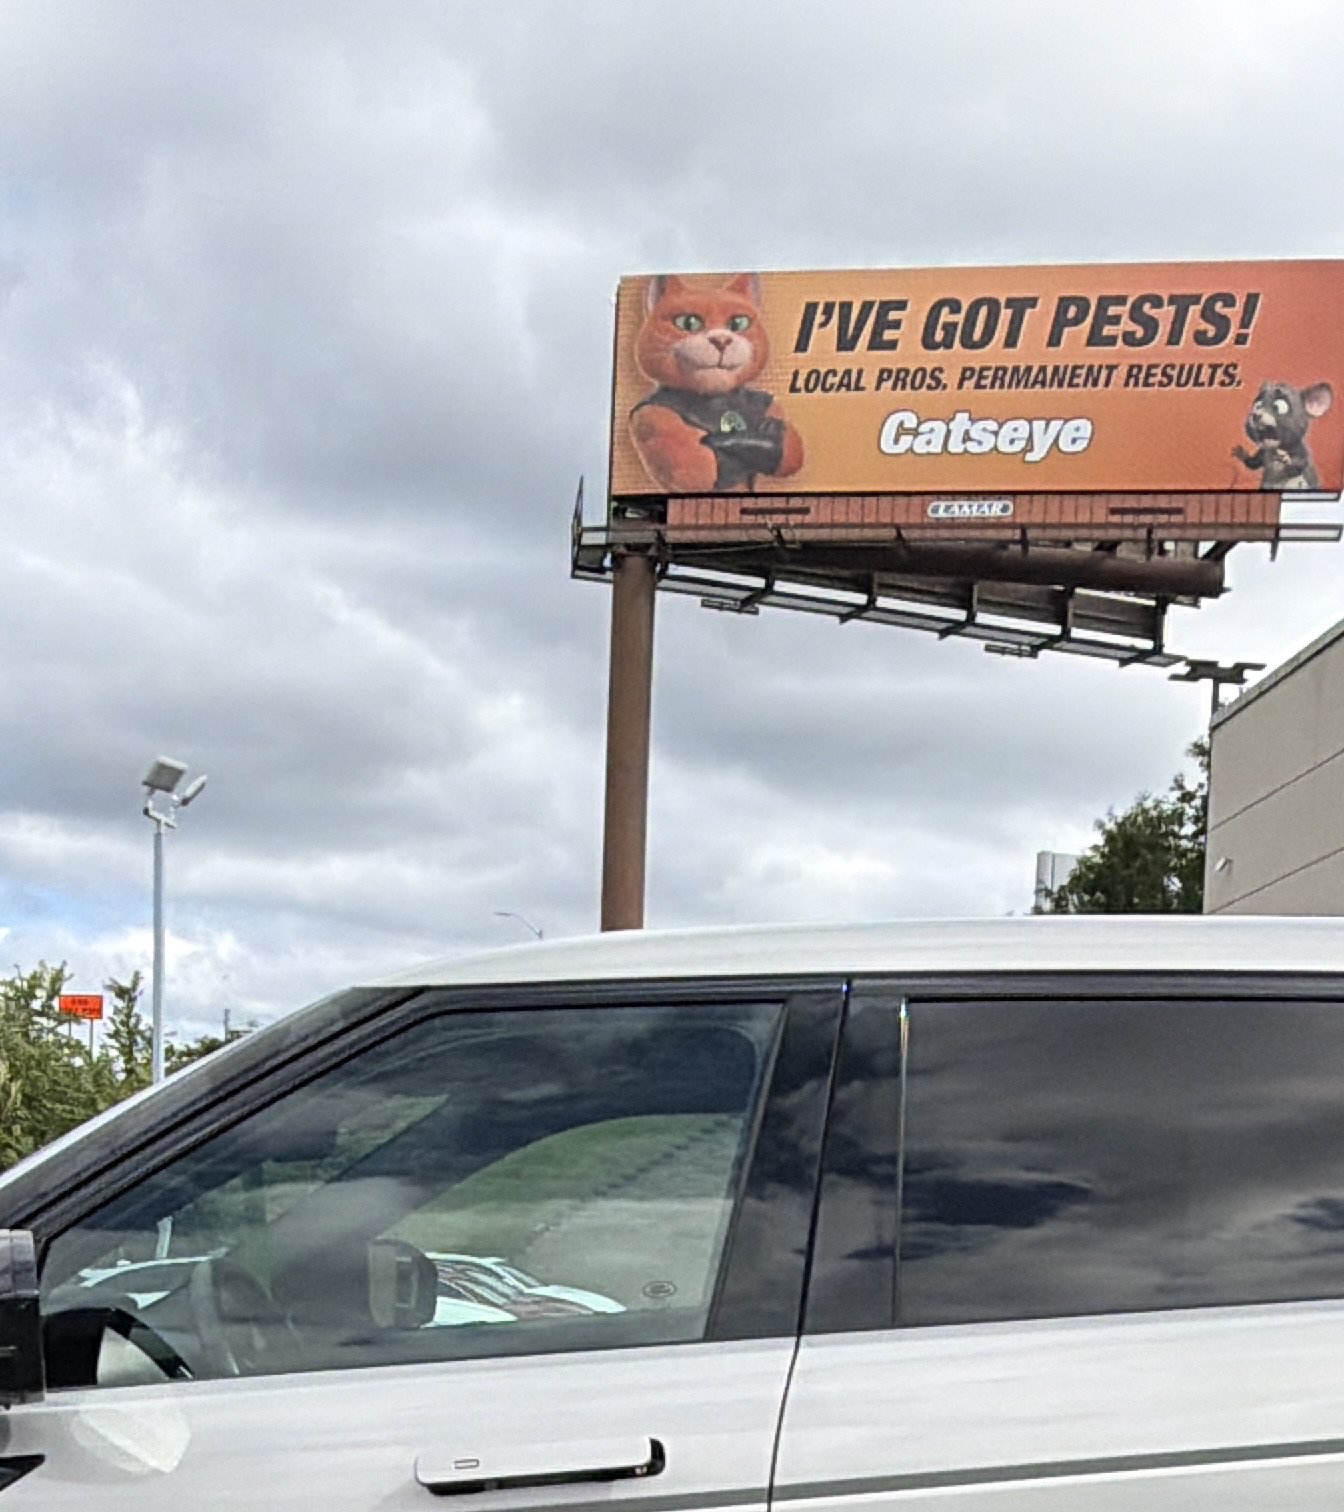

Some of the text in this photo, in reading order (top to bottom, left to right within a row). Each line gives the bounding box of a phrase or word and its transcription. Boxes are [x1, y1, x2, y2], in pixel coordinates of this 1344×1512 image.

[793, 292, 1262, 354] I'VE GOT PESTS!
[788, 361, 1243, 394] LOCAL PROS. PERMANENT RESULTS.
[879, 409, 1093, 463] Catseye
